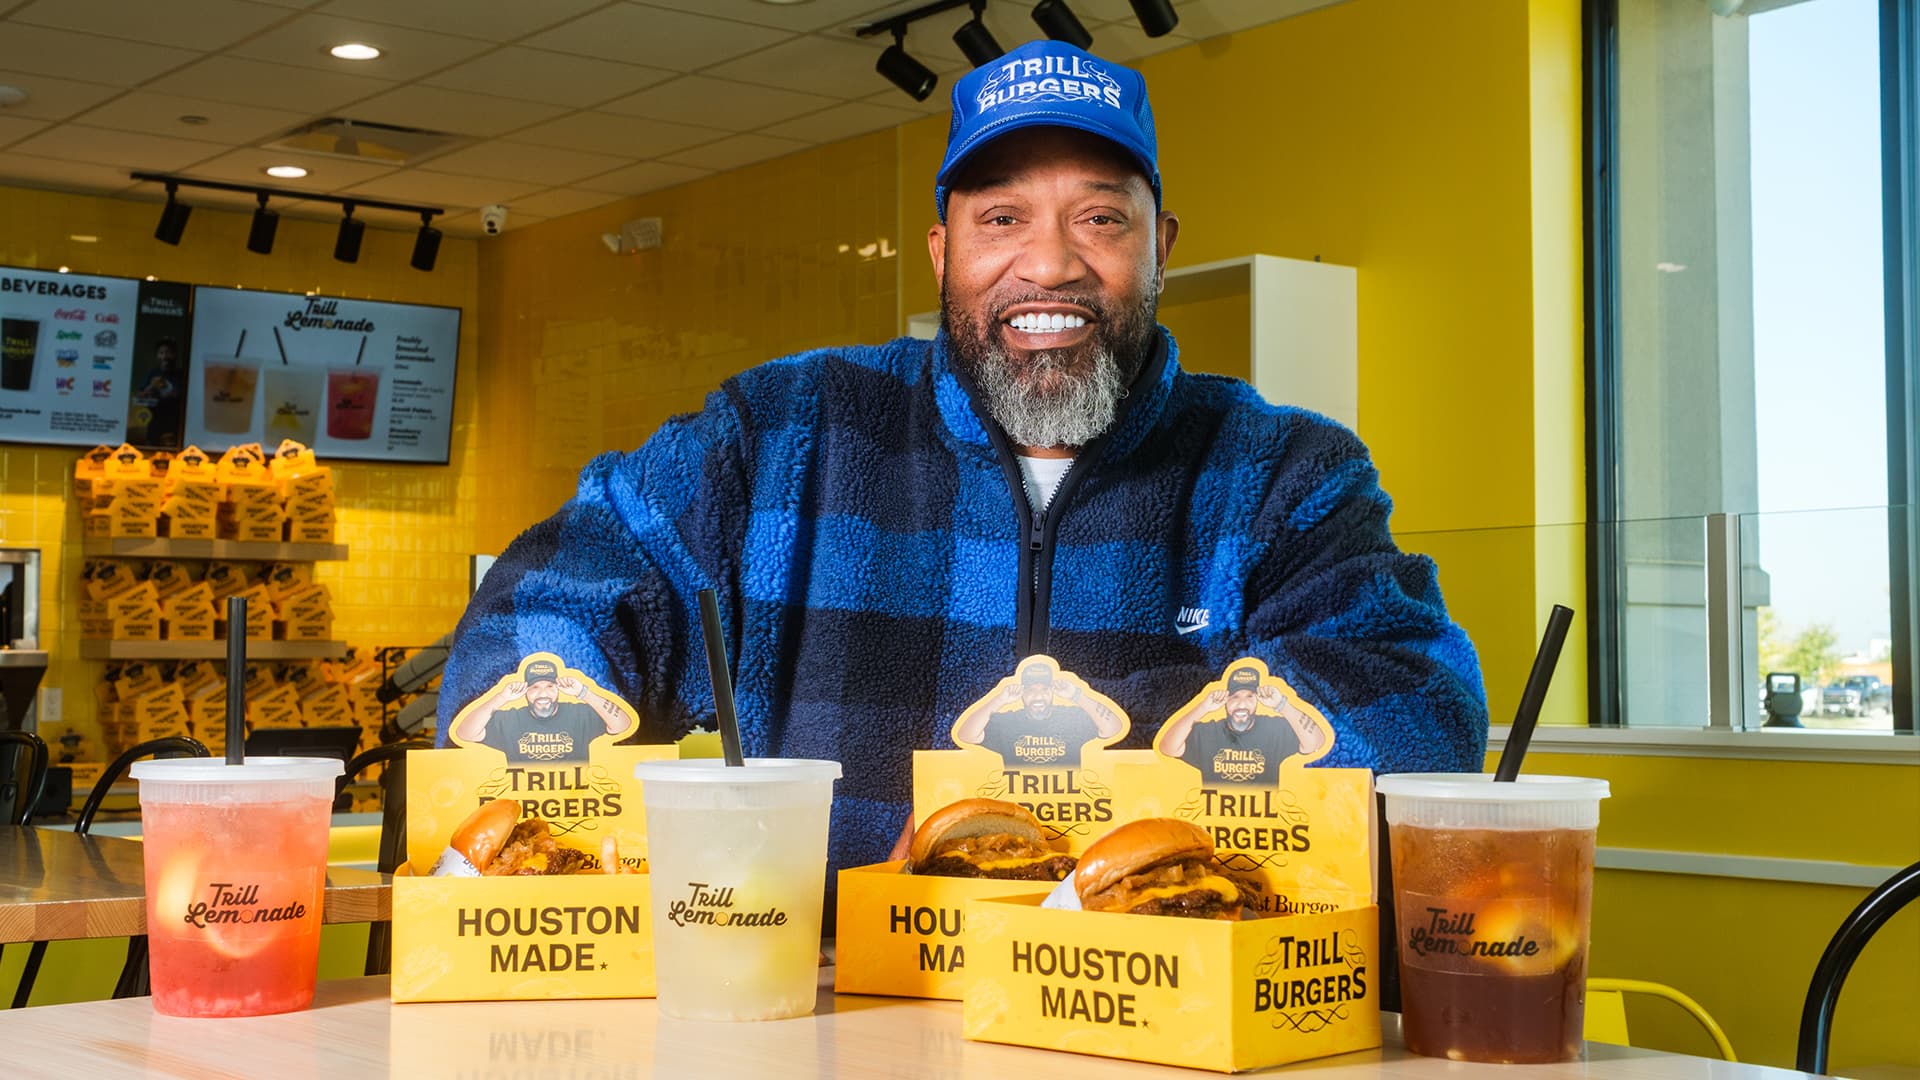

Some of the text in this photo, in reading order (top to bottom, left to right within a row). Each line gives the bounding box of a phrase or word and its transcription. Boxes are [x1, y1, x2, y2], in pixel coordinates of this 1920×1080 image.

[1002, 55, 1089, 82] TRILL
[978, 78, 1121, 114] BURGERS
[1, 278, 107, 300] BEVERAGES
[304, 295, 338, 316] Trill
[285, 310, 375, 332] Lemonade
[1177, 606, 1208, 625] NIKE
[519, 742, 574, 754] BURGERS
[529, 732, 562, 743] TRILL
[1024, 736, 1055, 746] TRILL
[1015, 745, 1066, 757] BURGERS
[1224, 749, 1254, 761] TRILL
[506, 767, 590, 792] TRILL
[1214, 761, 1265, 774] BURGERS
[1003, 771, 1081, 795] TRILL
[479, 793, 622, 818] RGERS
[1201, 789, 1279, 819] TRILL
[1206, 824, 1310, 852] RGERS
[210, 883, 259, 908] Trill
[688, 882, 734, 907] Trill
[184, 901, 306, 929] Lemonade
[458, 906, 640, 936] HOUSTON
[668, 900, 788, 927] Lemonade
[890, 905, 966, 936] HOU
[1426, 907, 1476, 935] Trill
[1279, 931, 1344, 969] TRILL
[1409, 927, 1539, 957] Lemonade
[490, 943, 595, 972] MADE
[1012, 940, 1179, 988] HOUSTON
[1255, 966, 1367, 1012] BURGERS
[1041, 985, 1137, 1028] MADE
